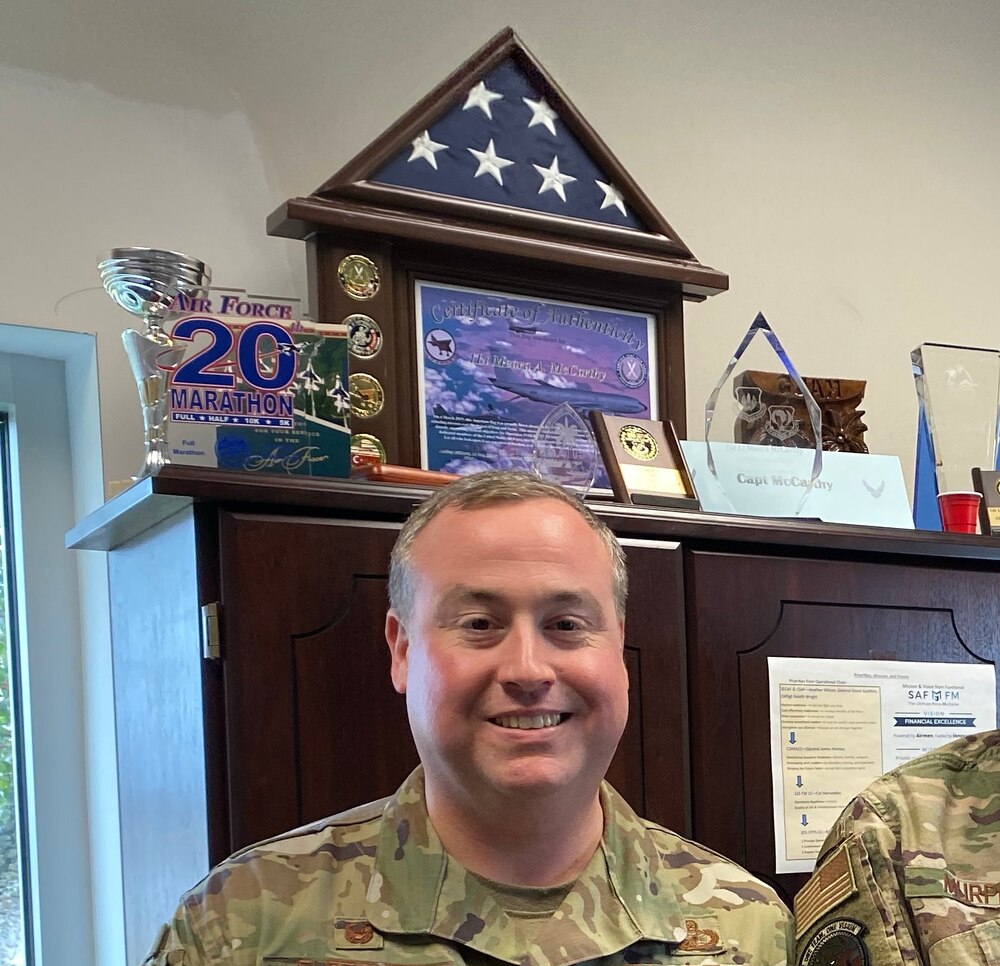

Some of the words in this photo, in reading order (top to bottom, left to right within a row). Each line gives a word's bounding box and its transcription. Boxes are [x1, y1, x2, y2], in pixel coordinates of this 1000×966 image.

[168, 292, 213, 314] AIR
[217, 295, 292, 320] FORCE
[431, 299, 518, 323] Certificate
[523, 304, 539, 326] of
[545, 308, 645, 351] Authenticity
[170, 388, 294, 416] MARATHON
[175, 413, 196, 421] FULL
[245, 416, 260, 424] 10K
[279, 417, 290, 426] 5K
[172, 448, 205, 456] Marathon
[736, 473, 769, 487] Capt
[908, 690, 928, 700] SAF
[945, 691, 959, 700] FM
